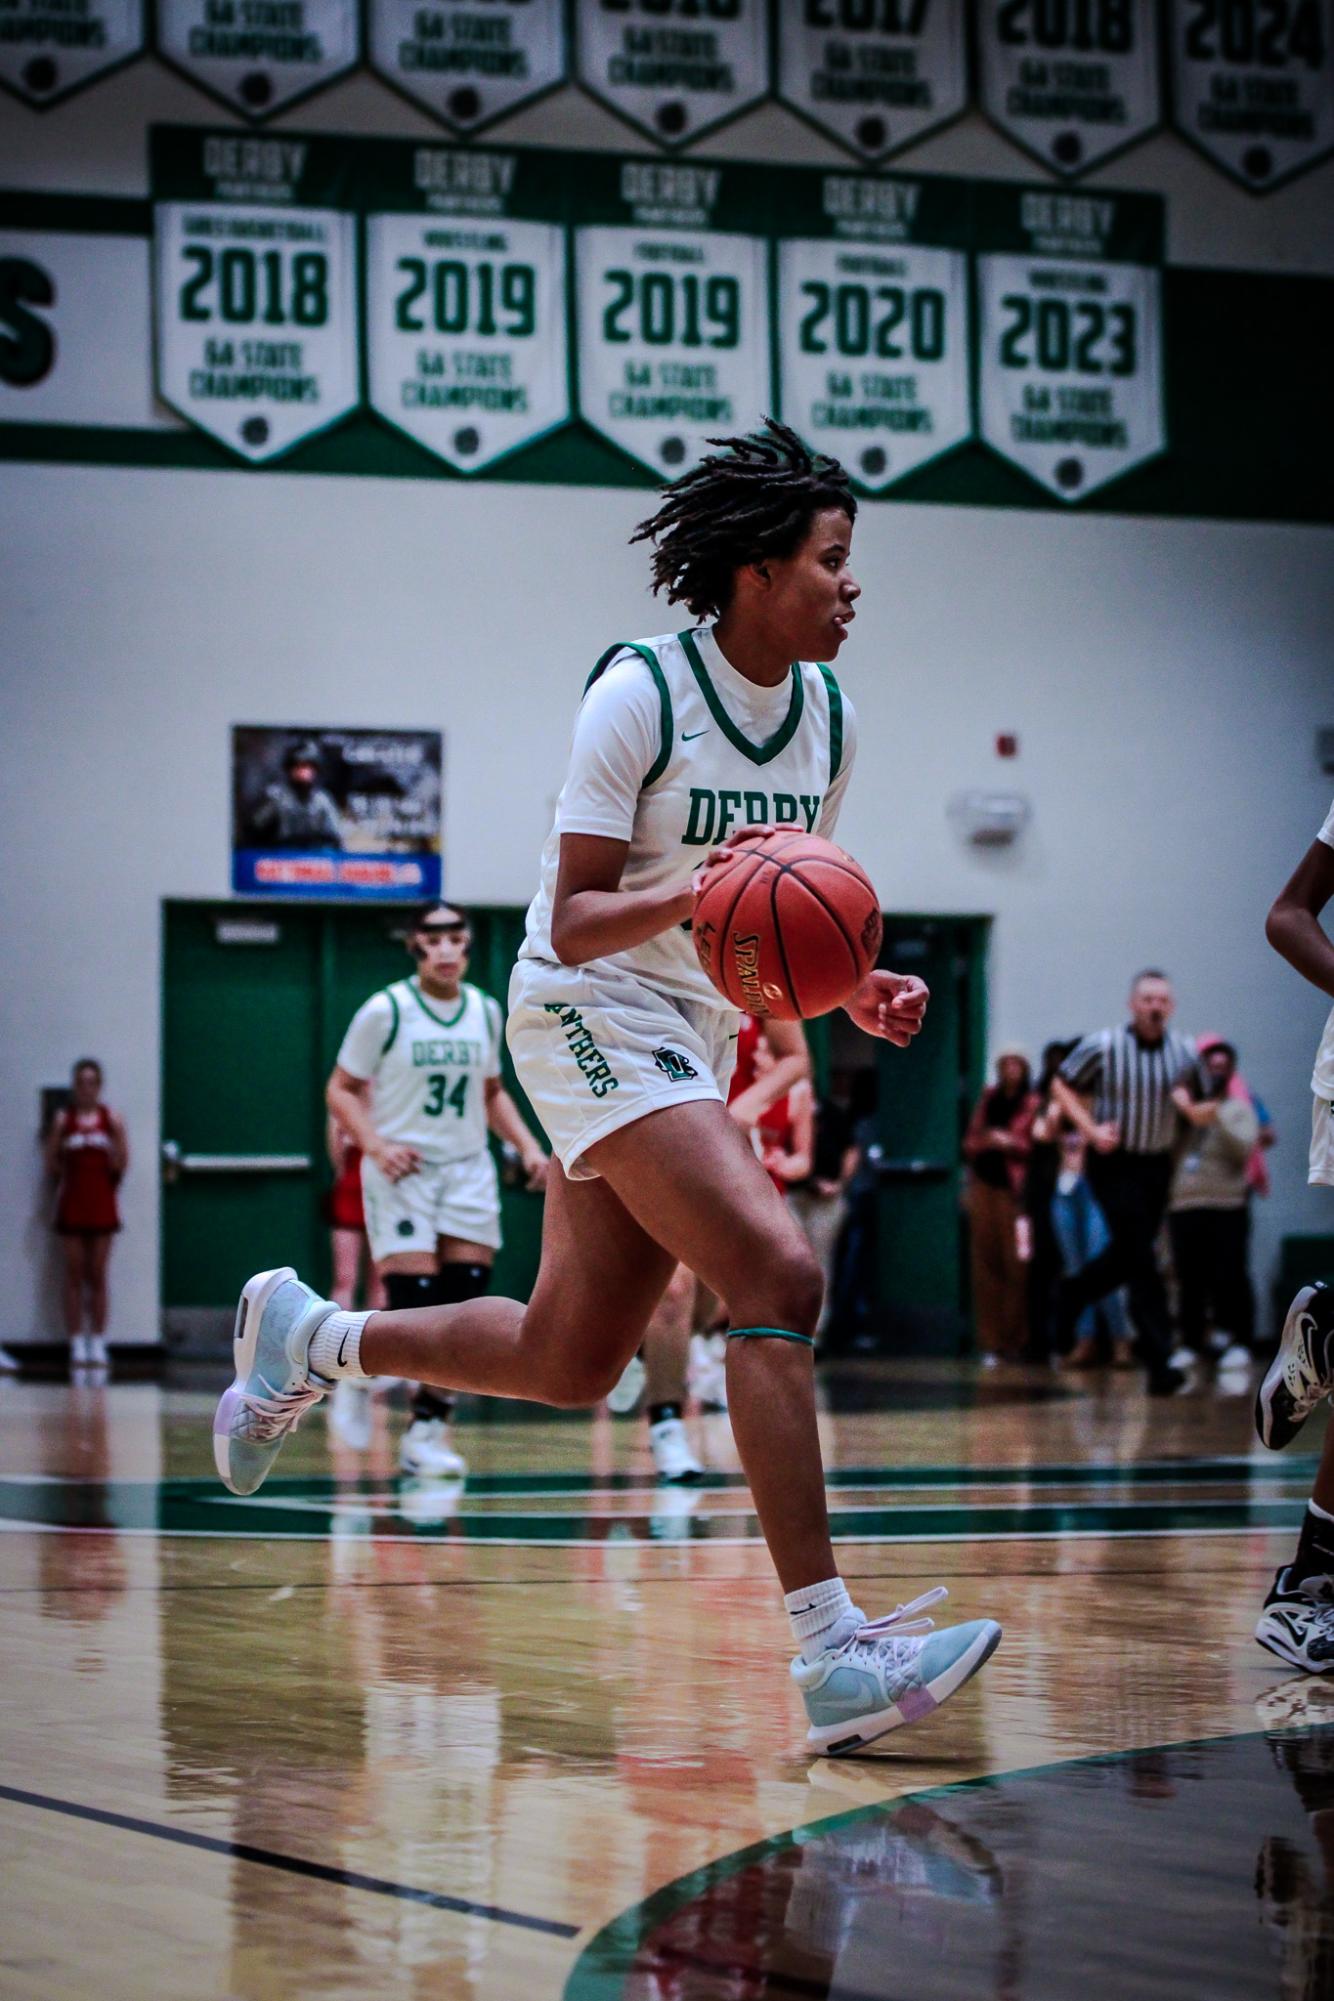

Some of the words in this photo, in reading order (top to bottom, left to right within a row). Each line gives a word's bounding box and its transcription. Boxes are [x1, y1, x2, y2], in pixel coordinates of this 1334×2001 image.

[999, 0, 1131, 53] 2018
[1187, 0, 1324, 70] 2024
[180, 247, 328, 327] 2018
[395, 258, 536, 338] 2019
[603, 270, 740, 349] 2019
[800, 282, 945, 361] 2020
[1000, 297, 1135, 377] 2023
[240, 340, 304, 372] STATE
[452, 350, 511, 383] STATE
[189, 368, 320, 404] CHAMPIONS
[658, 362, 716, 392] STATE
[860, 373, 917, 403] STATE
[402, 380, 529, 416] CHAMPIONS
[609, 390, 733, 425] CHAMPIONS
[1055, 388, 1111, 417] STATE
[812, 401, 933, 435] CHAMPIONS
[1010, 414, 1128, 450] CHAMPIONS
[734, 930, 778, 1018] SPALDIN
[424, 1073, 468, 1118] 34
